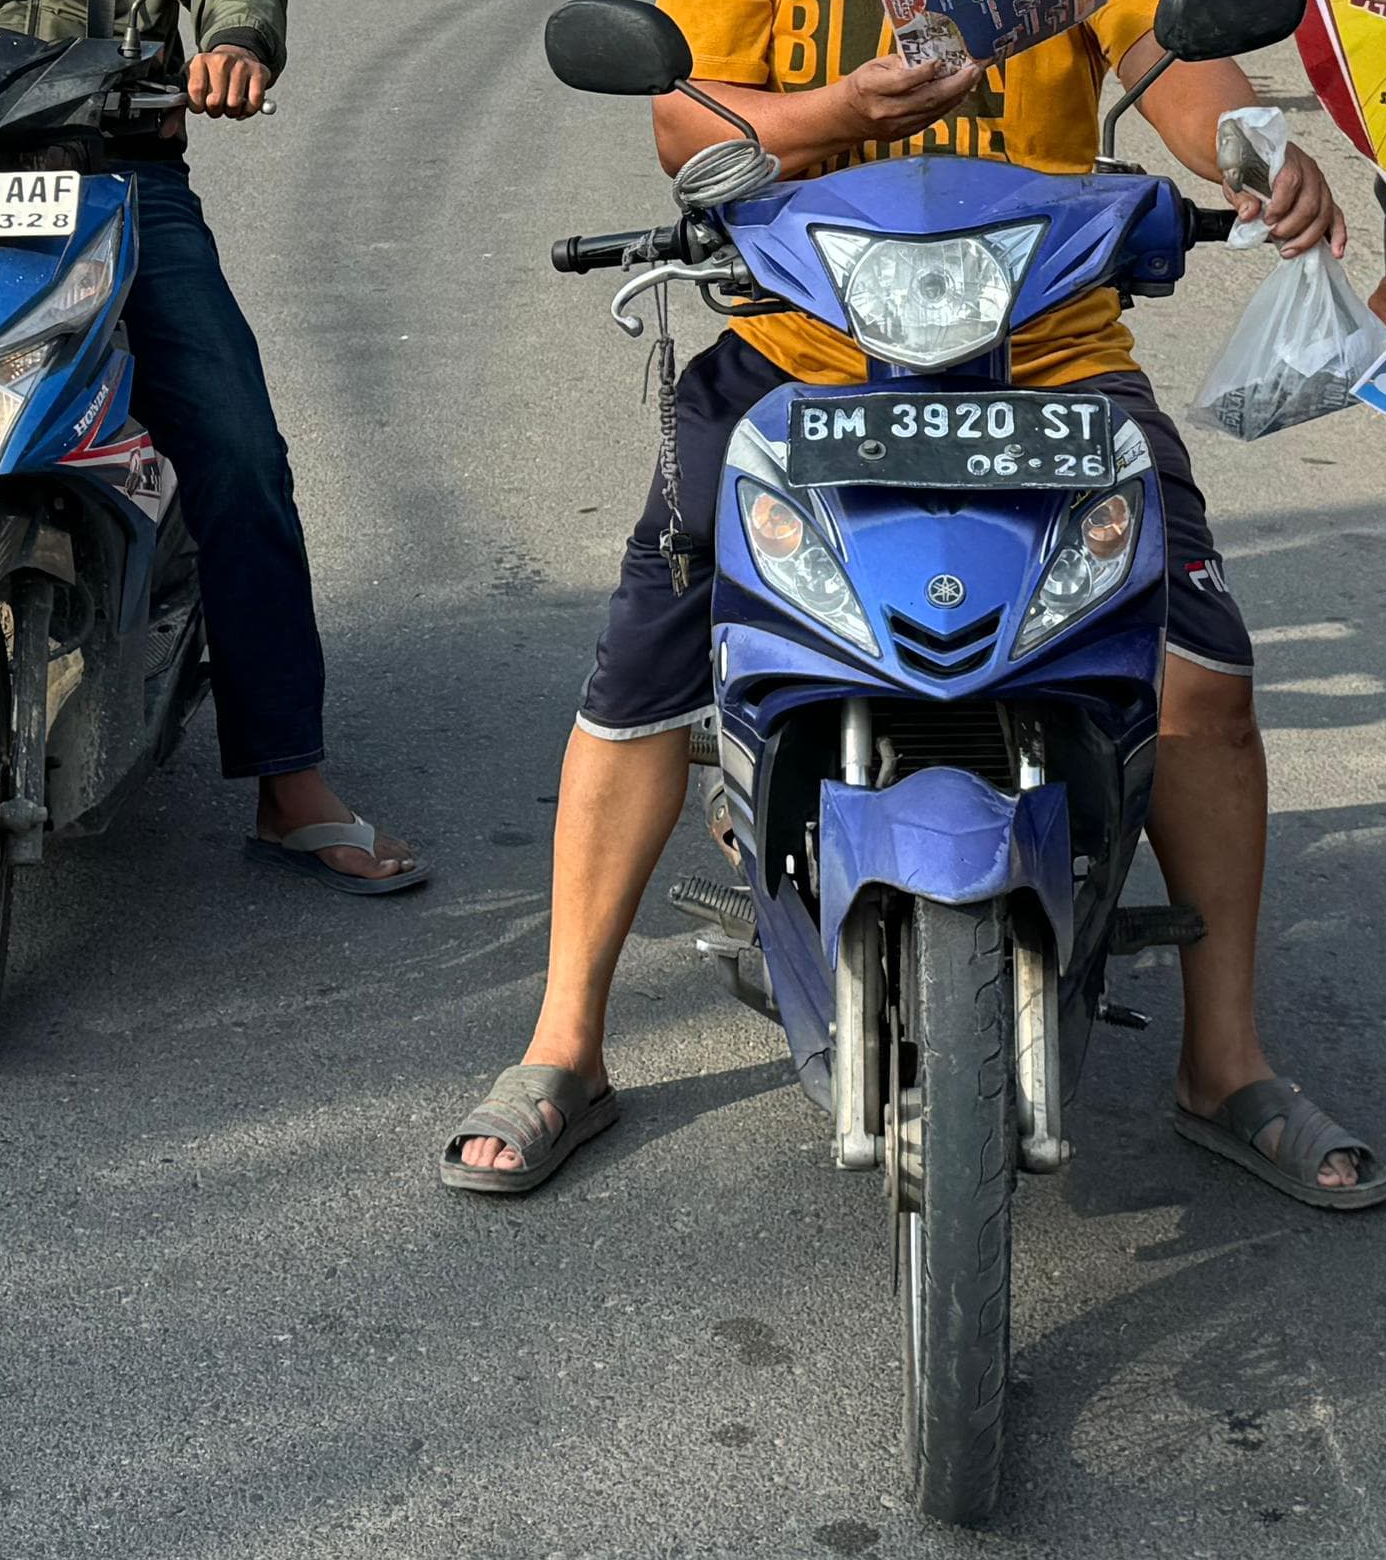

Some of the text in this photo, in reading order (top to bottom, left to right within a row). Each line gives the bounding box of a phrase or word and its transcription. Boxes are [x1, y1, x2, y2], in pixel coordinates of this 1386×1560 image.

[5, 175, 75, 203] AAF
[73, 384, 109, 437] HONDA
[801, 400, 1101, 441] BM 3920 ST
